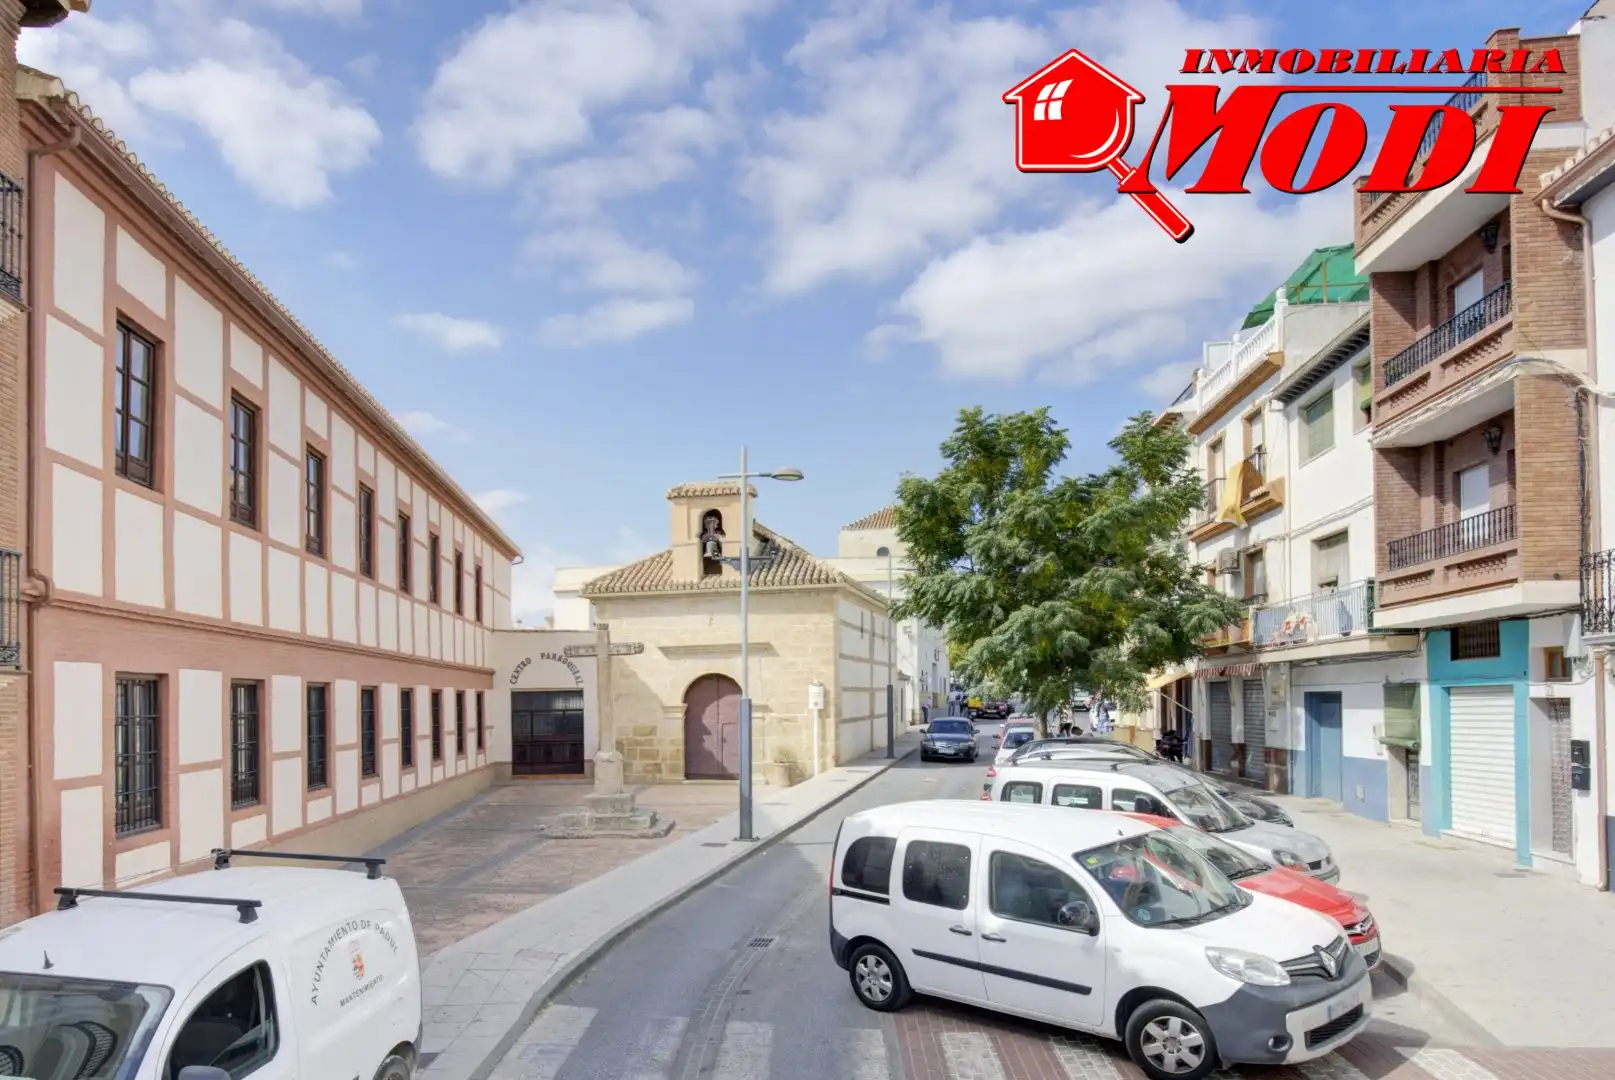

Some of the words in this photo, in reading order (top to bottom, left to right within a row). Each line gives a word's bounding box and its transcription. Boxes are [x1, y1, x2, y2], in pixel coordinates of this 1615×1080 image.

[510, 657, 532, 684] CENTRO
[540, 652, 584, 685] PARROQUIAL
[311, 920, 359, 1005] AYUNTAMIENTO
[360, 919, 371, 930] DE
[340, 974, 383, 1006] MANTENIMIENTO
